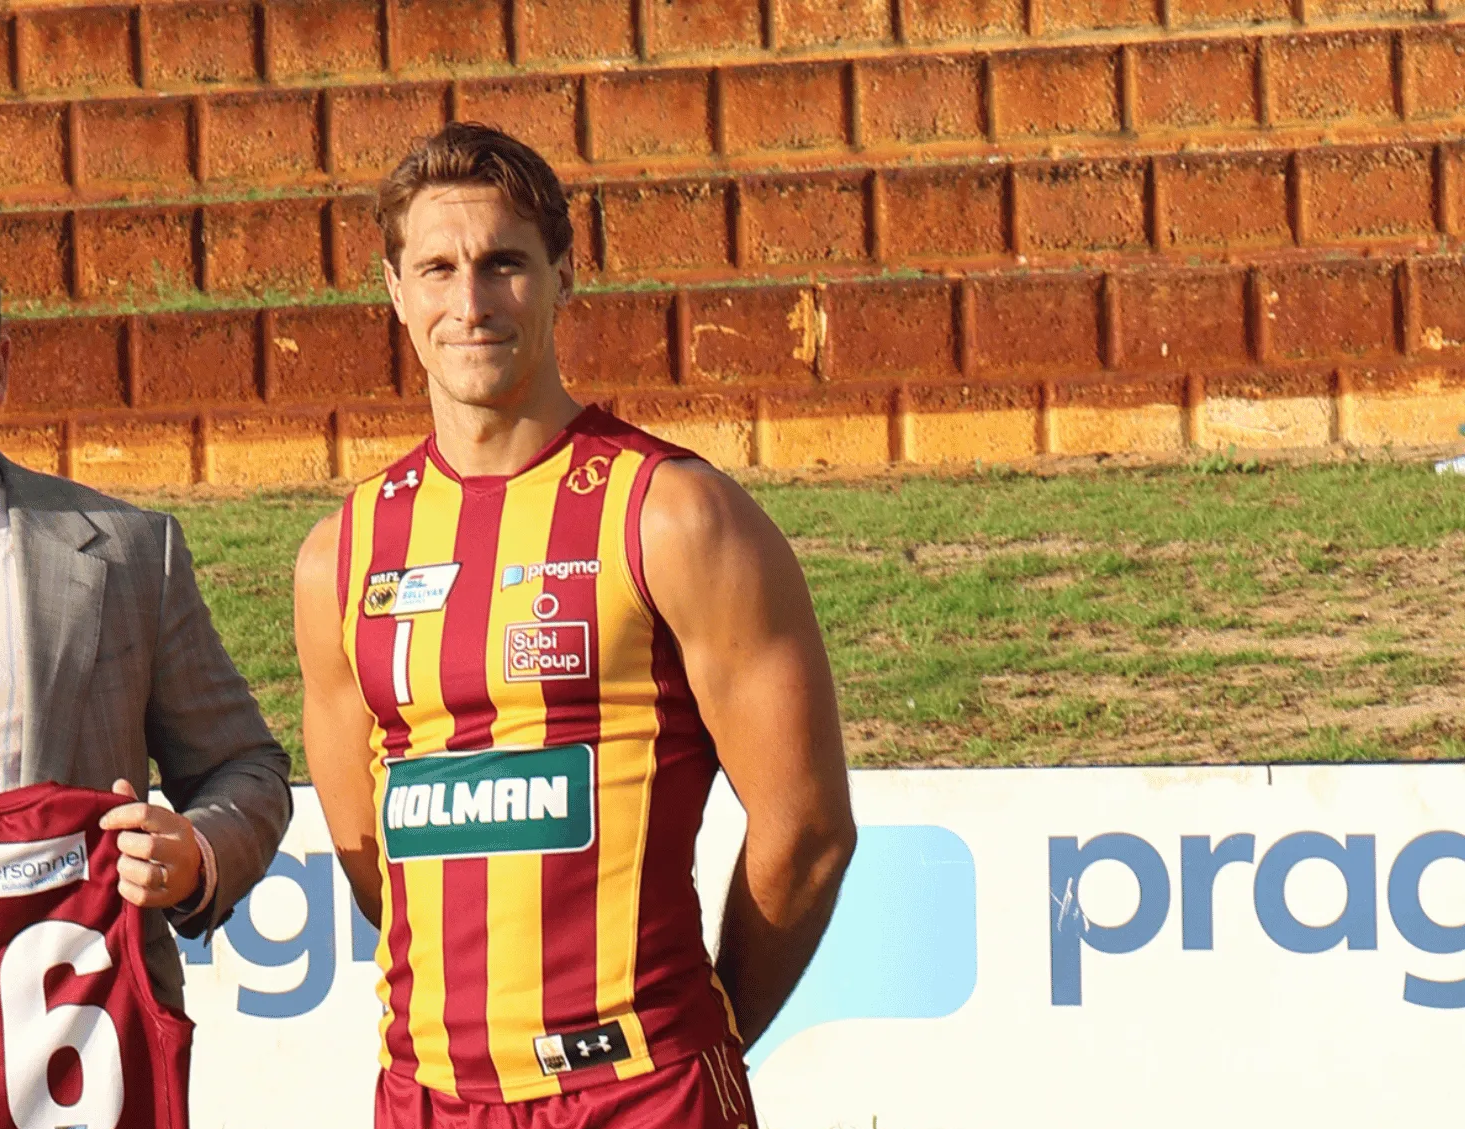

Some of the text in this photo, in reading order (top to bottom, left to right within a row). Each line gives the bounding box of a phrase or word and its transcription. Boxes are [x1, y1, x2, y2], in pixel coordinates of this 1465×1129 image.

[527, 560, 601, 583] pragma
[513, 630, 558, 651] Subi
[512, 651, 581, 672] Group
[387, 775, 569, 829] HOLMAN
[1048, 829, 1465, 1009] prag
